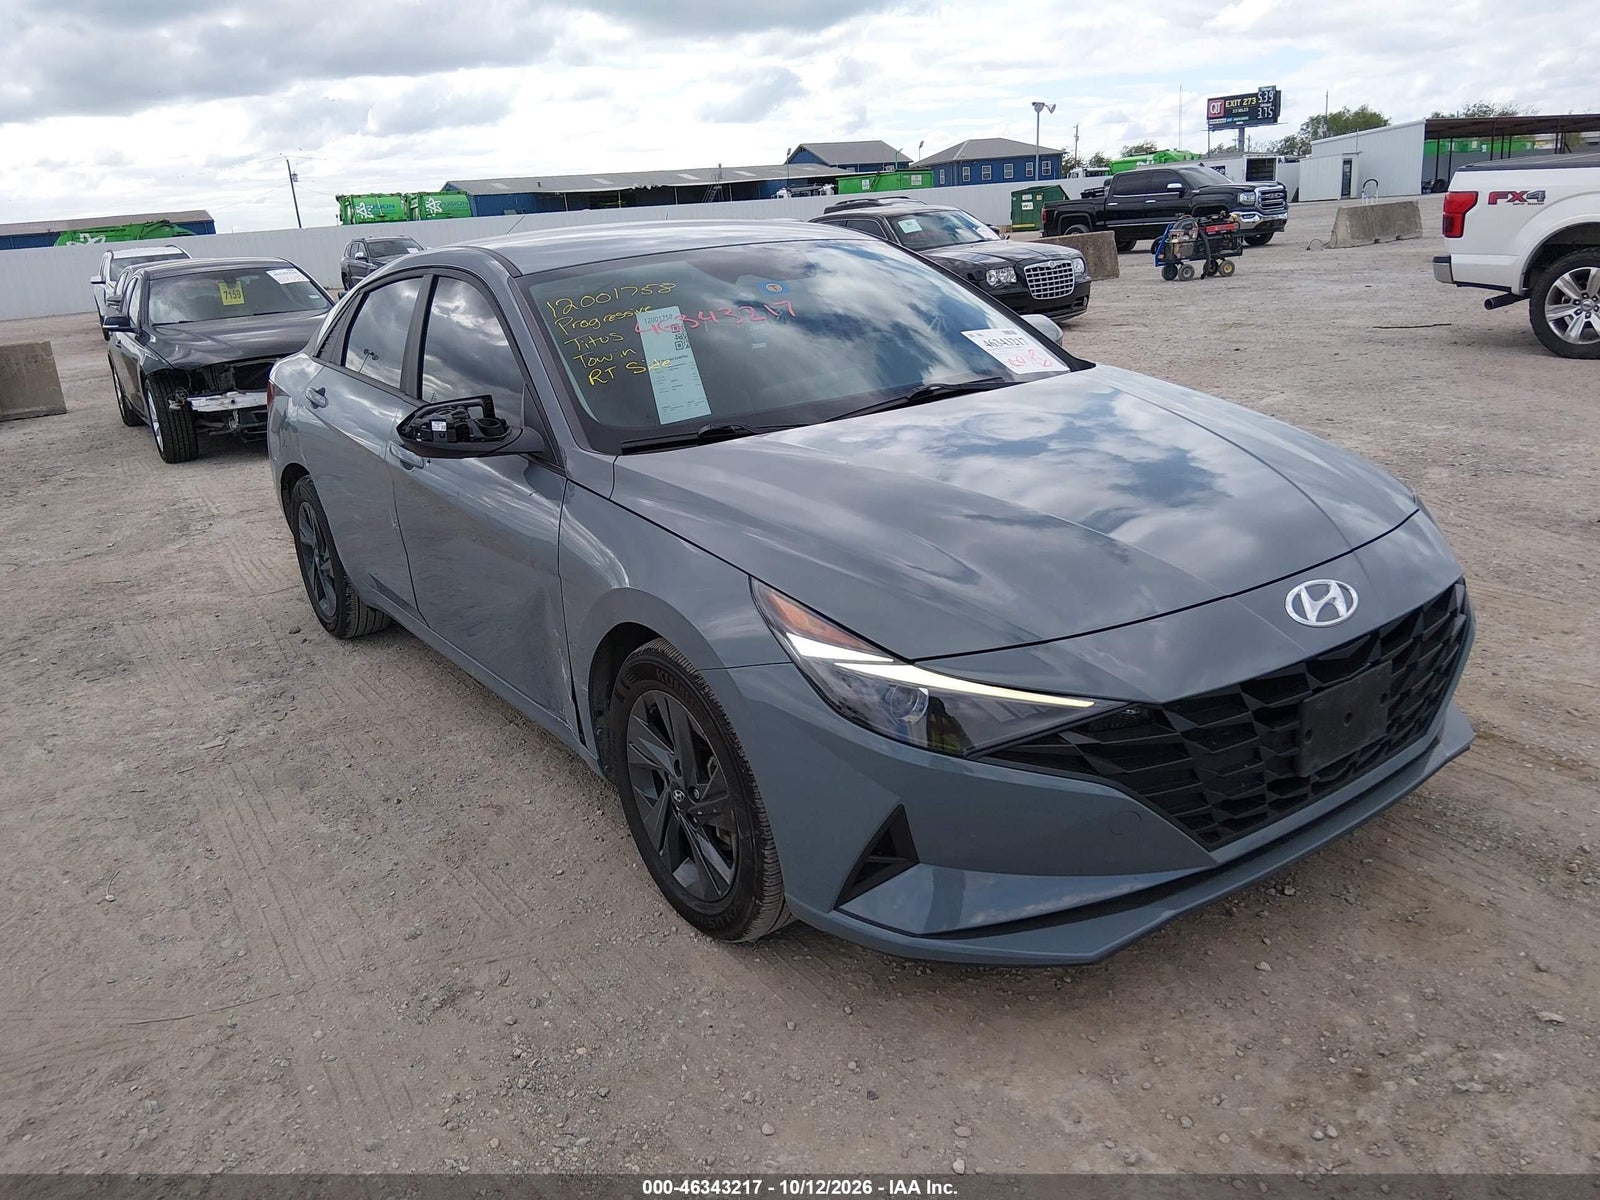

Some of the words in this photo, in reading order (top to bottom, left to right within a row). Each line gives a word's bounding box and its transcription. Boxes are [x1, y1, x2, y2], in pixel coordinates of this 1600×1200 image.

[1209, 102, 1222, 115] QT
[1225, 99, 1241, 107] EXIT
[1243, 97, 1257, 106] 273
[1488, 190, 1546, 205] FX4
[223, 290, 241, 300] 7159
[547, 283, 676, 318] 12001758
[555, 305, 651, 336] Progressive
[635, 300, 796, 335] 46343217
[573, 351, 613, 369] Tow
[619, 348, 637, 358] in
[588, 365, 617, 386] RT
[625, 358, 673, 374] Side
